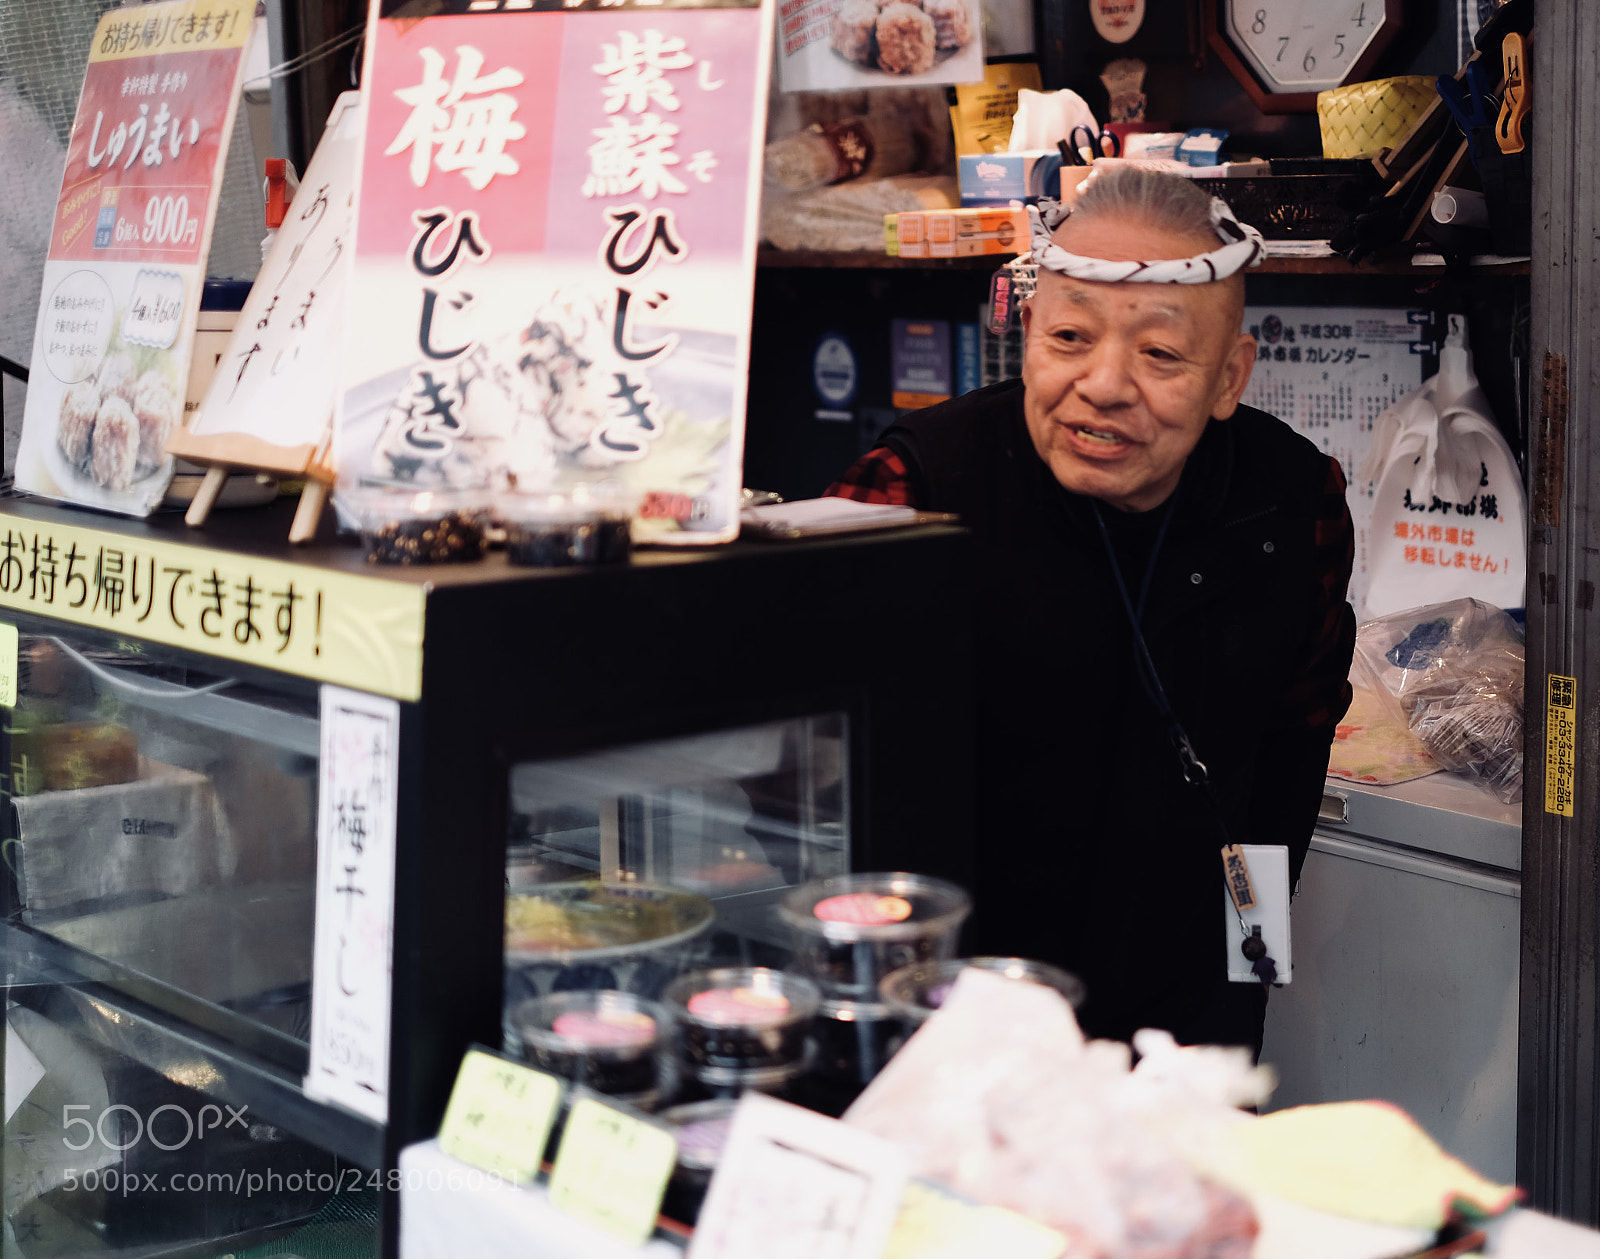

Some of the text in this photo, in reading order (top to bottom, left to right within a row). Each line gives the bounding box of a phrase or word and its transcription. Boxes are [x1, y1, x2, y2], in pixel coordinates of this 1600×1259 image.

[1252, 9, 1267, 34] 8
[1351, 1, 1366, 27] 4
[1276, 37, 1290, 61] 7
[1333, 34, 1346, 59] 5
[1303, 48, 1316, 72] 6
[87, 102, 200, 170] しゅうまい
[1300, 324, 1353, 339] 平成30年
[1306, 346, 1371, 364] カレンダー
[1394, 521, 1475, 547] 場外市場は
[1404, 545, 1509, 575] 移転しません！
[0, 528, 324, 657] お持ち帰りできます！
[1556, 719, 1567, 812] 03-3346-2280
